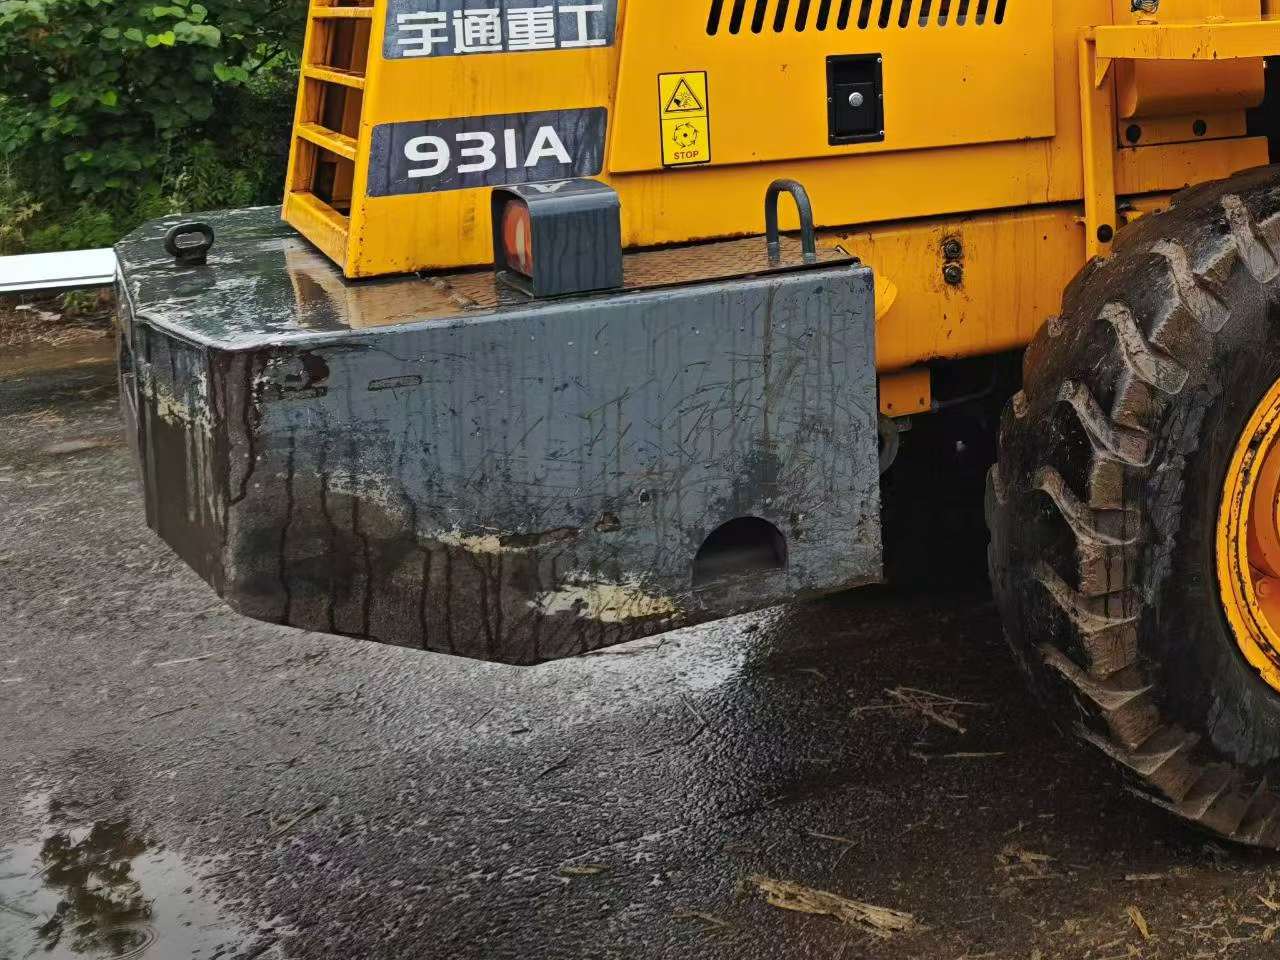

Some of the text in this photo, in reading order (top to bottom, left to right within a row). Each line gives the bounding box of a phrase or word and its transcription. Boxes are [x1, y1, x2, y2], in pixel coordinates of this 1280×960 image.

[396, 5, 607, 57] 宇通重工
[404, 125, 573, 178] 931A
[673, 150, 699, 160] STOP
